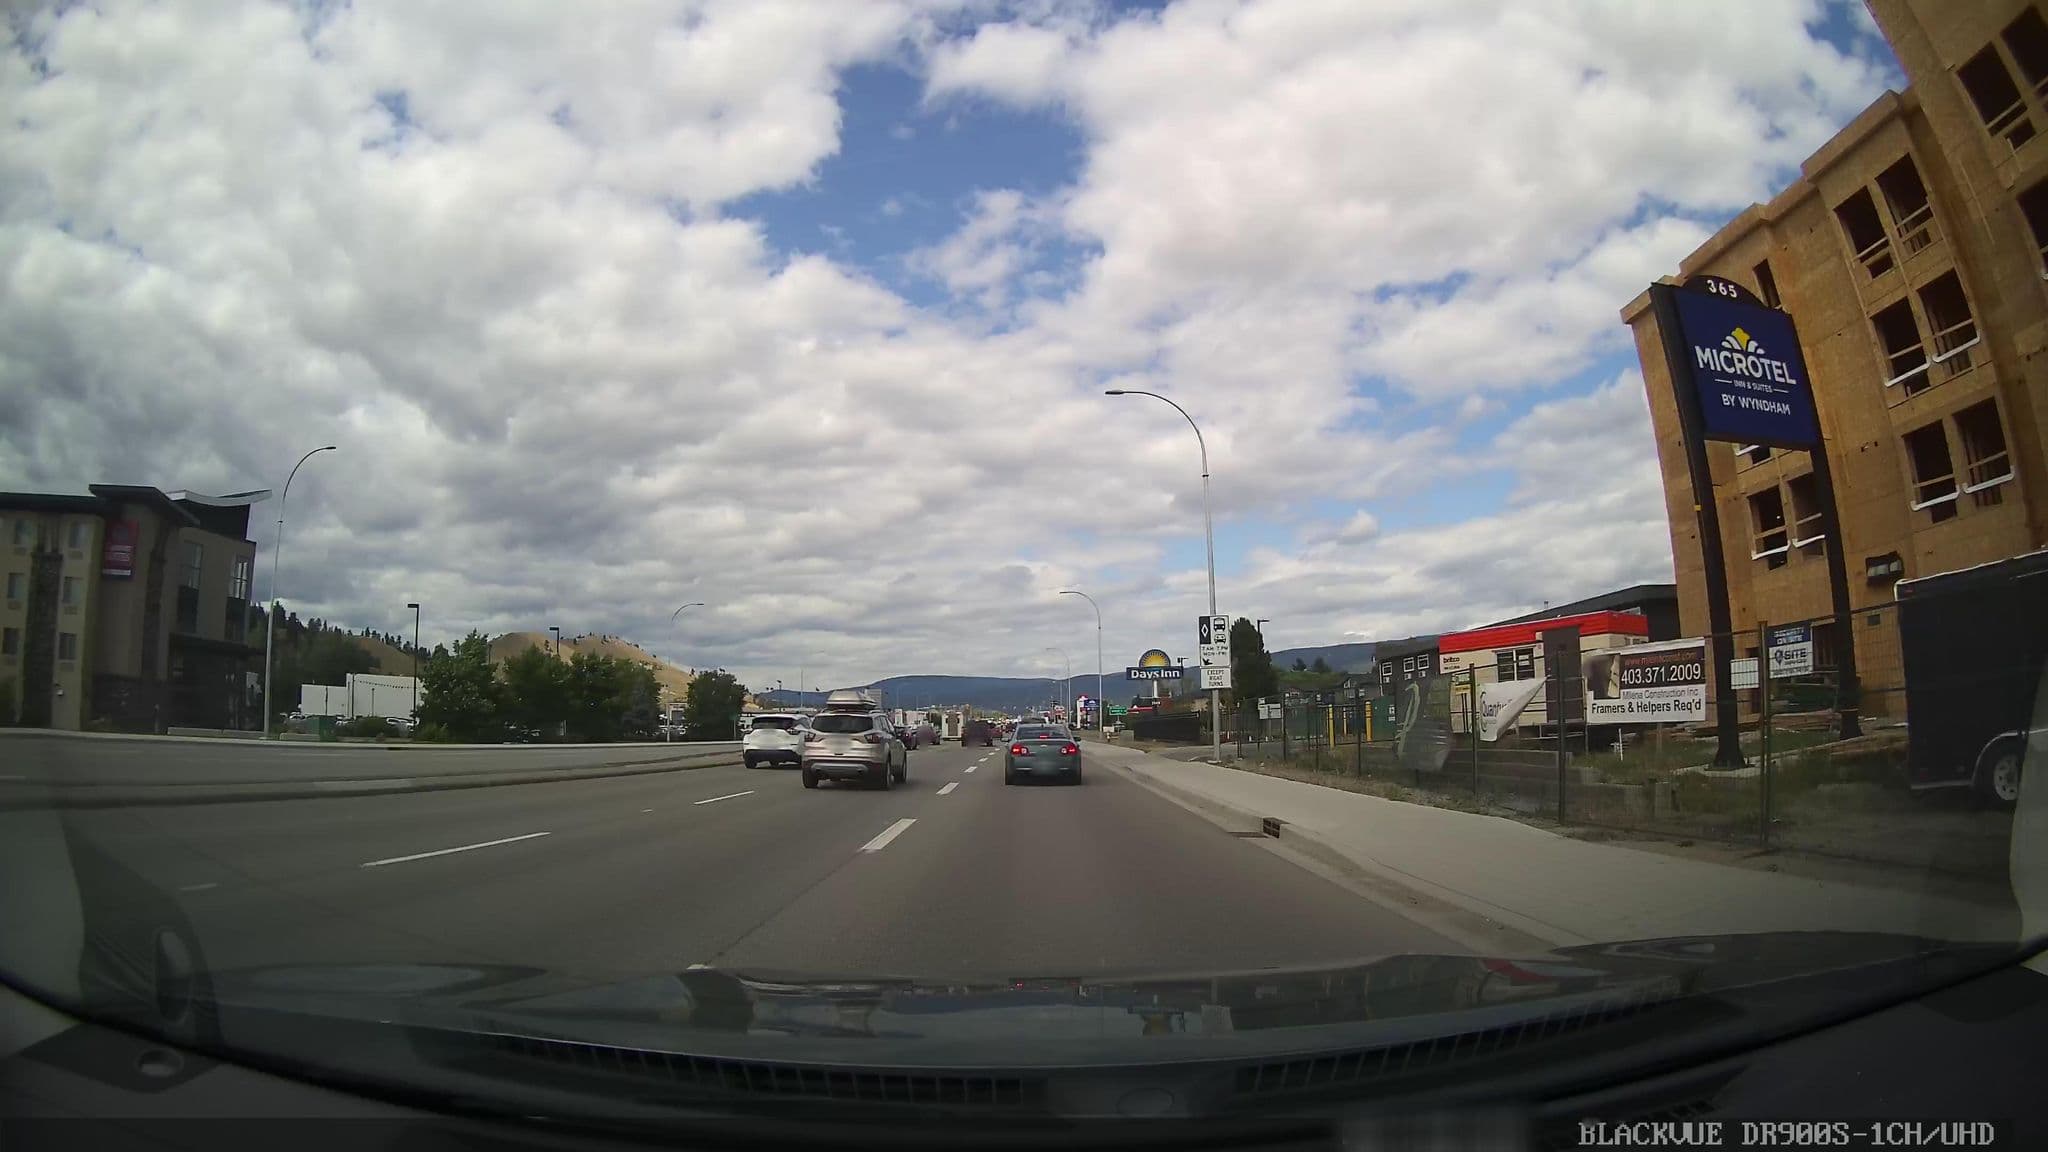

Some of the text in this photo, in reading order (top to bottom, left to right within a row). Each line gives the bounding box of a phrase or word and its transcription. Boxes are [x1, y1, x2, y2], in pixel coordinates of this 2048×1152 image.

[1707, 280, 1737, 298] 365
[1694, 345, 1797, 385] MICROTEL
[1733, 379, 1746, 389] INN
[1753, 382, 1773, 394] SUITES
[1721, 393, 1791, 416] BY WYNDHAM
[1784, 648, 1808, 660] SITE
[1131, 669, 1180, 679] Days Inn
[1621, 662, 1701, 685] 403.371.2009
[1645, 688, 1686, 699] Construction
[1591, 698, 1701, 715] Framers & Helpers Req'd
